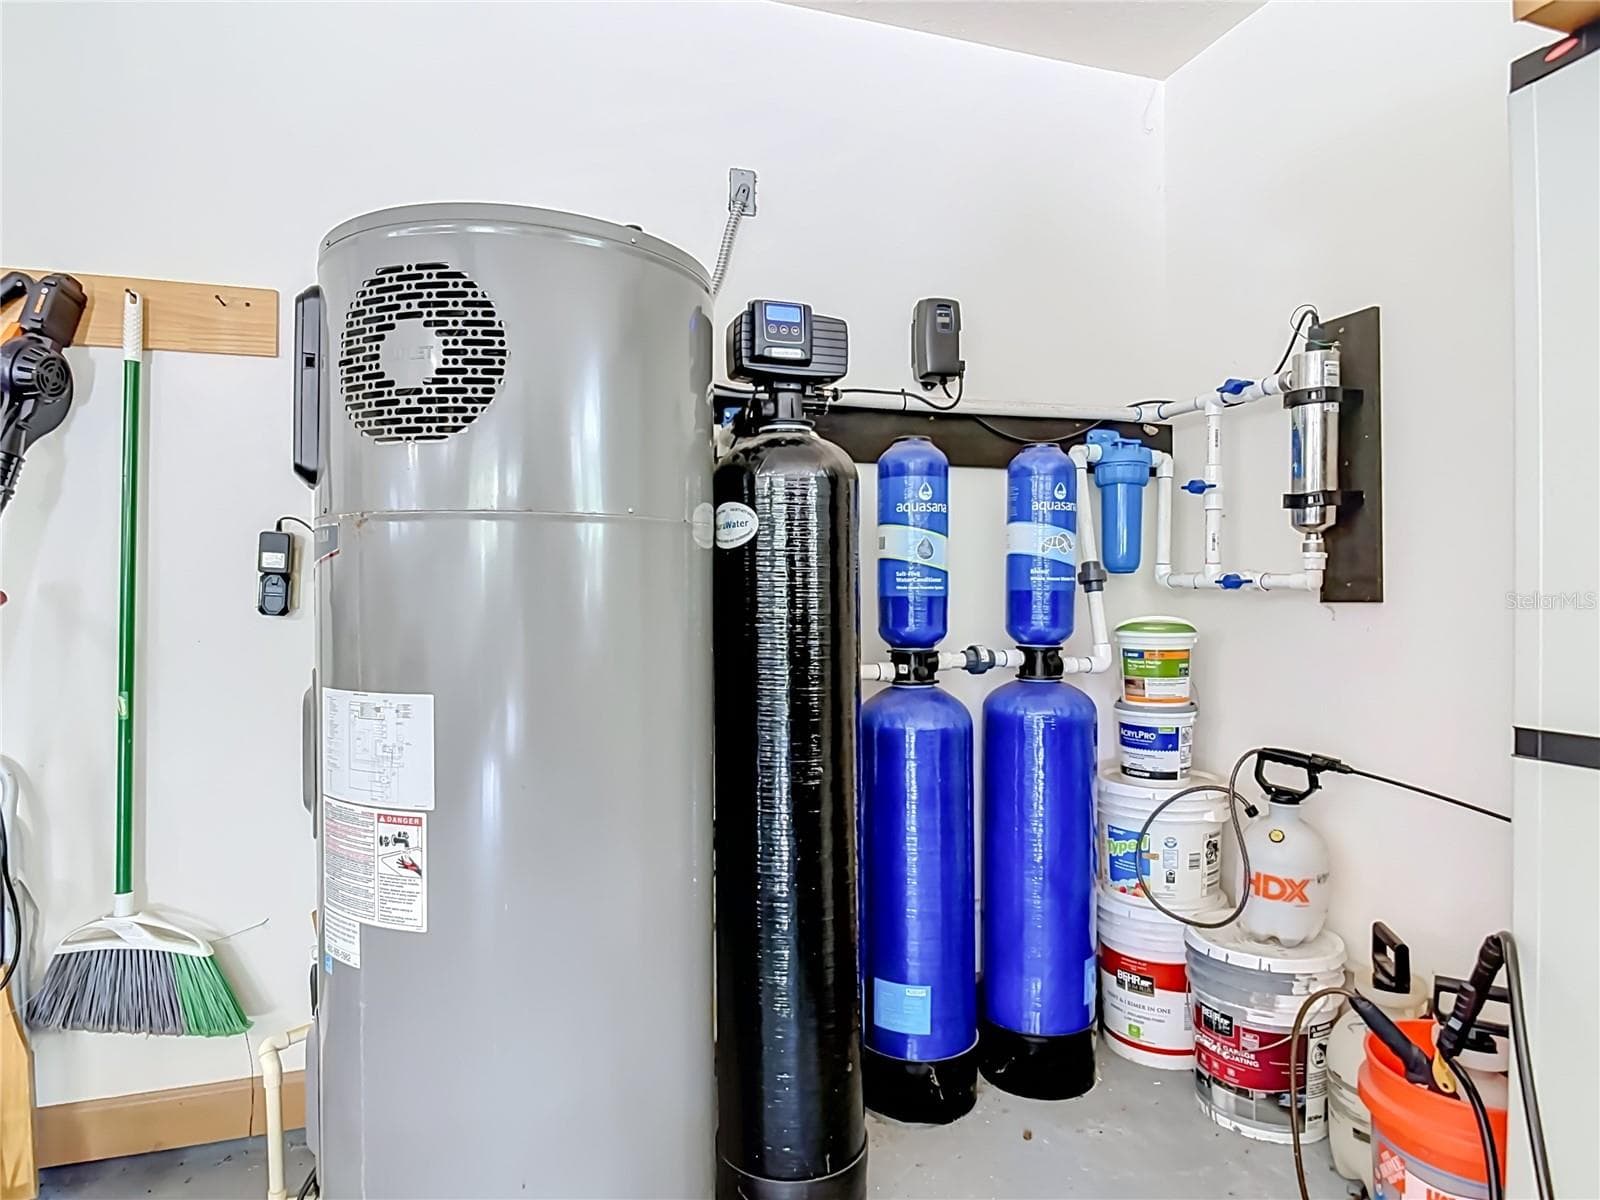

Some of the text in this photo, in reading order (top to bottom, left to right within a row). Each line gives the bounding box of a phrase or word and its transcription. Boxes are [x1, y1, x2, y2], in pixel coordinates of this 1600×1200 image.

[896, 502, 947, 515] aquasana
[1031, 501, 1077, 514] aquasan
[386, 816, 419, 825] DANGER
[1117, 968, 1141, 986] BEHR
